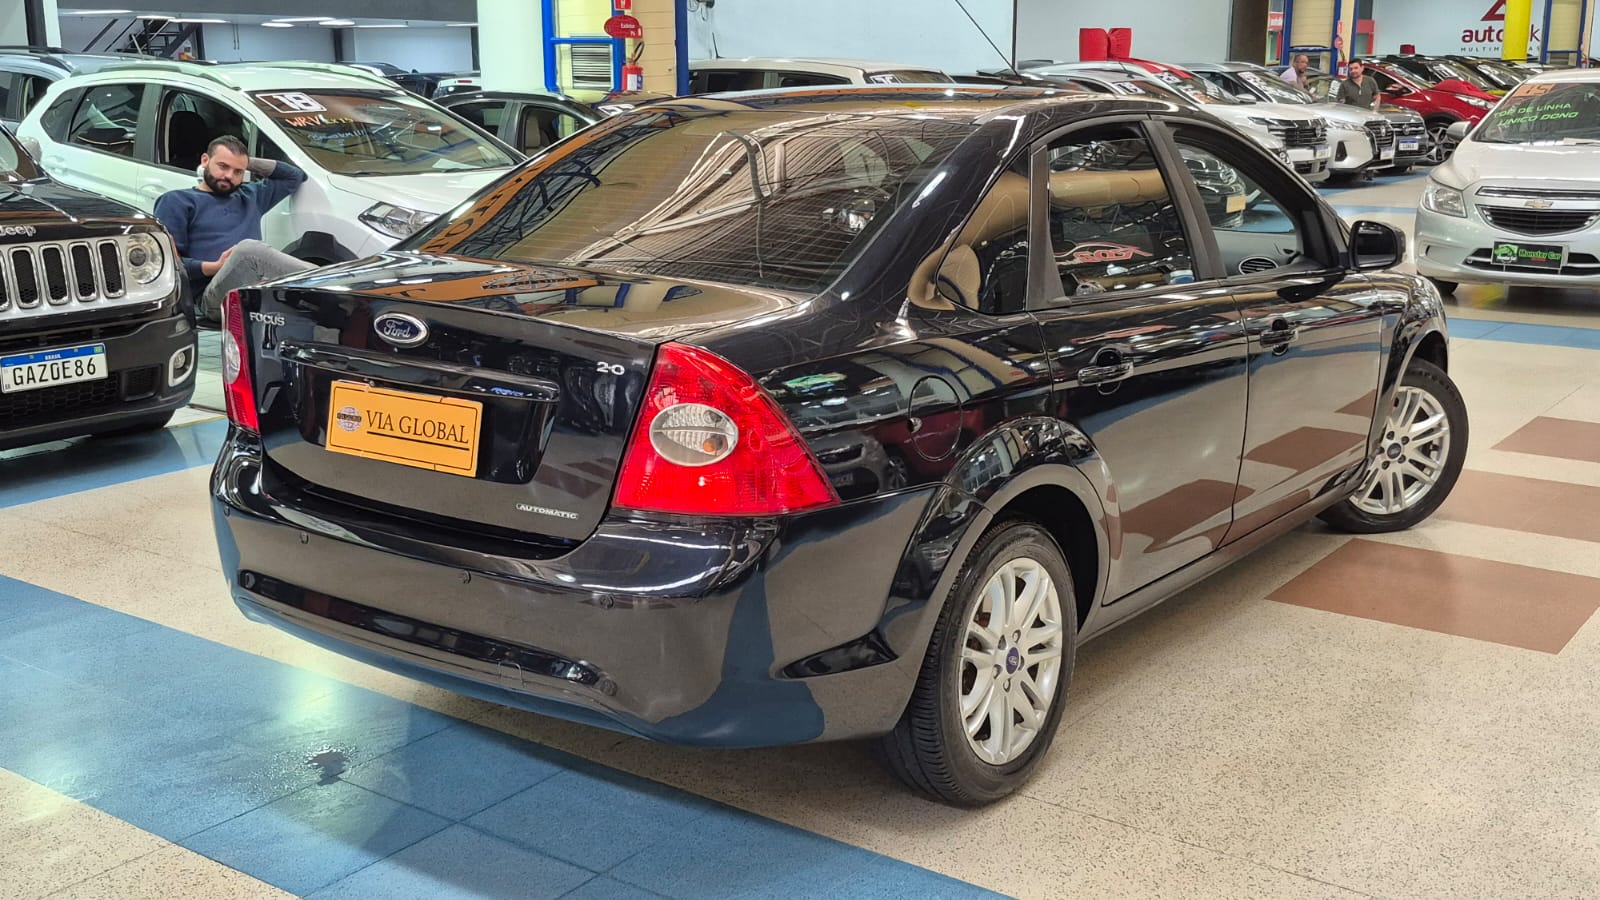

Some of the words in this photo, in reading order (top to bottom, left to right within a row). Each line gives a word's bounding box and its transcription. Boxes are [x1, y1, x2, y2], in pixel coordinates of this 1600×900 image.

[1518, 106, 1534, 114] DE
[1540, 111, 1579, 121] DONO
[249, 312, 285, 326] FOCUS
[383, 319, 412, 338] Ford
[366, 409, 394, 432] VIA
[399, 415, 469, 444] GLOBAL
[515, 493, 578, 519] AUTOMATIC
